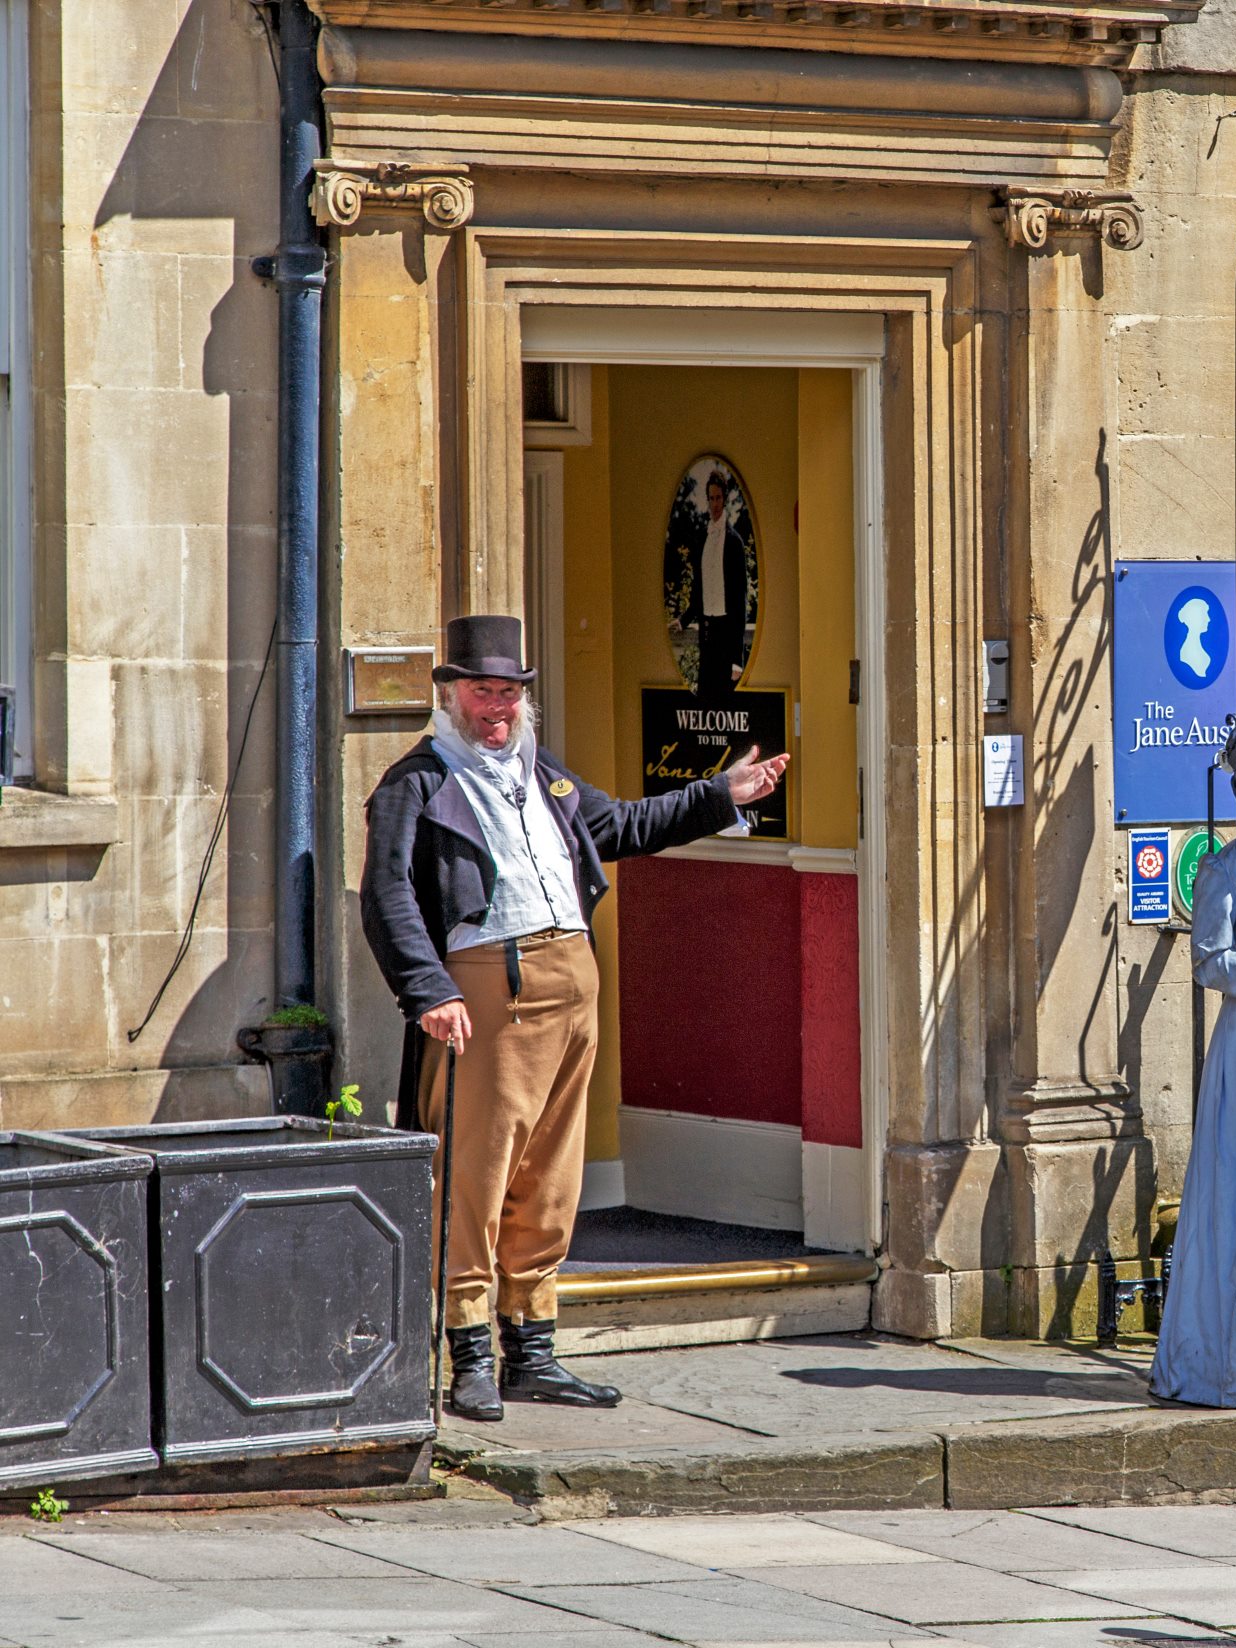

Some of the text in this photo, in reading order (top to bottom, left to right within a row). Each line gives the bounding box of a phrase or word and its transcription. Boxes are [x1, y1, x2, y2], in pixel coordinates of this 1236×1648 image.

[1144, 700, 1175, 719] The
[676, 709, 749, 732] WELCOME
[697, 734, 729, 746] TO THE
[1128, 718, 1184, 753] Jane
[646, 742, 696, 778] Jane
[1133, 904, 1168, 912] ATTRACTION
[1140, 897, 1161, 905] VISITOR
